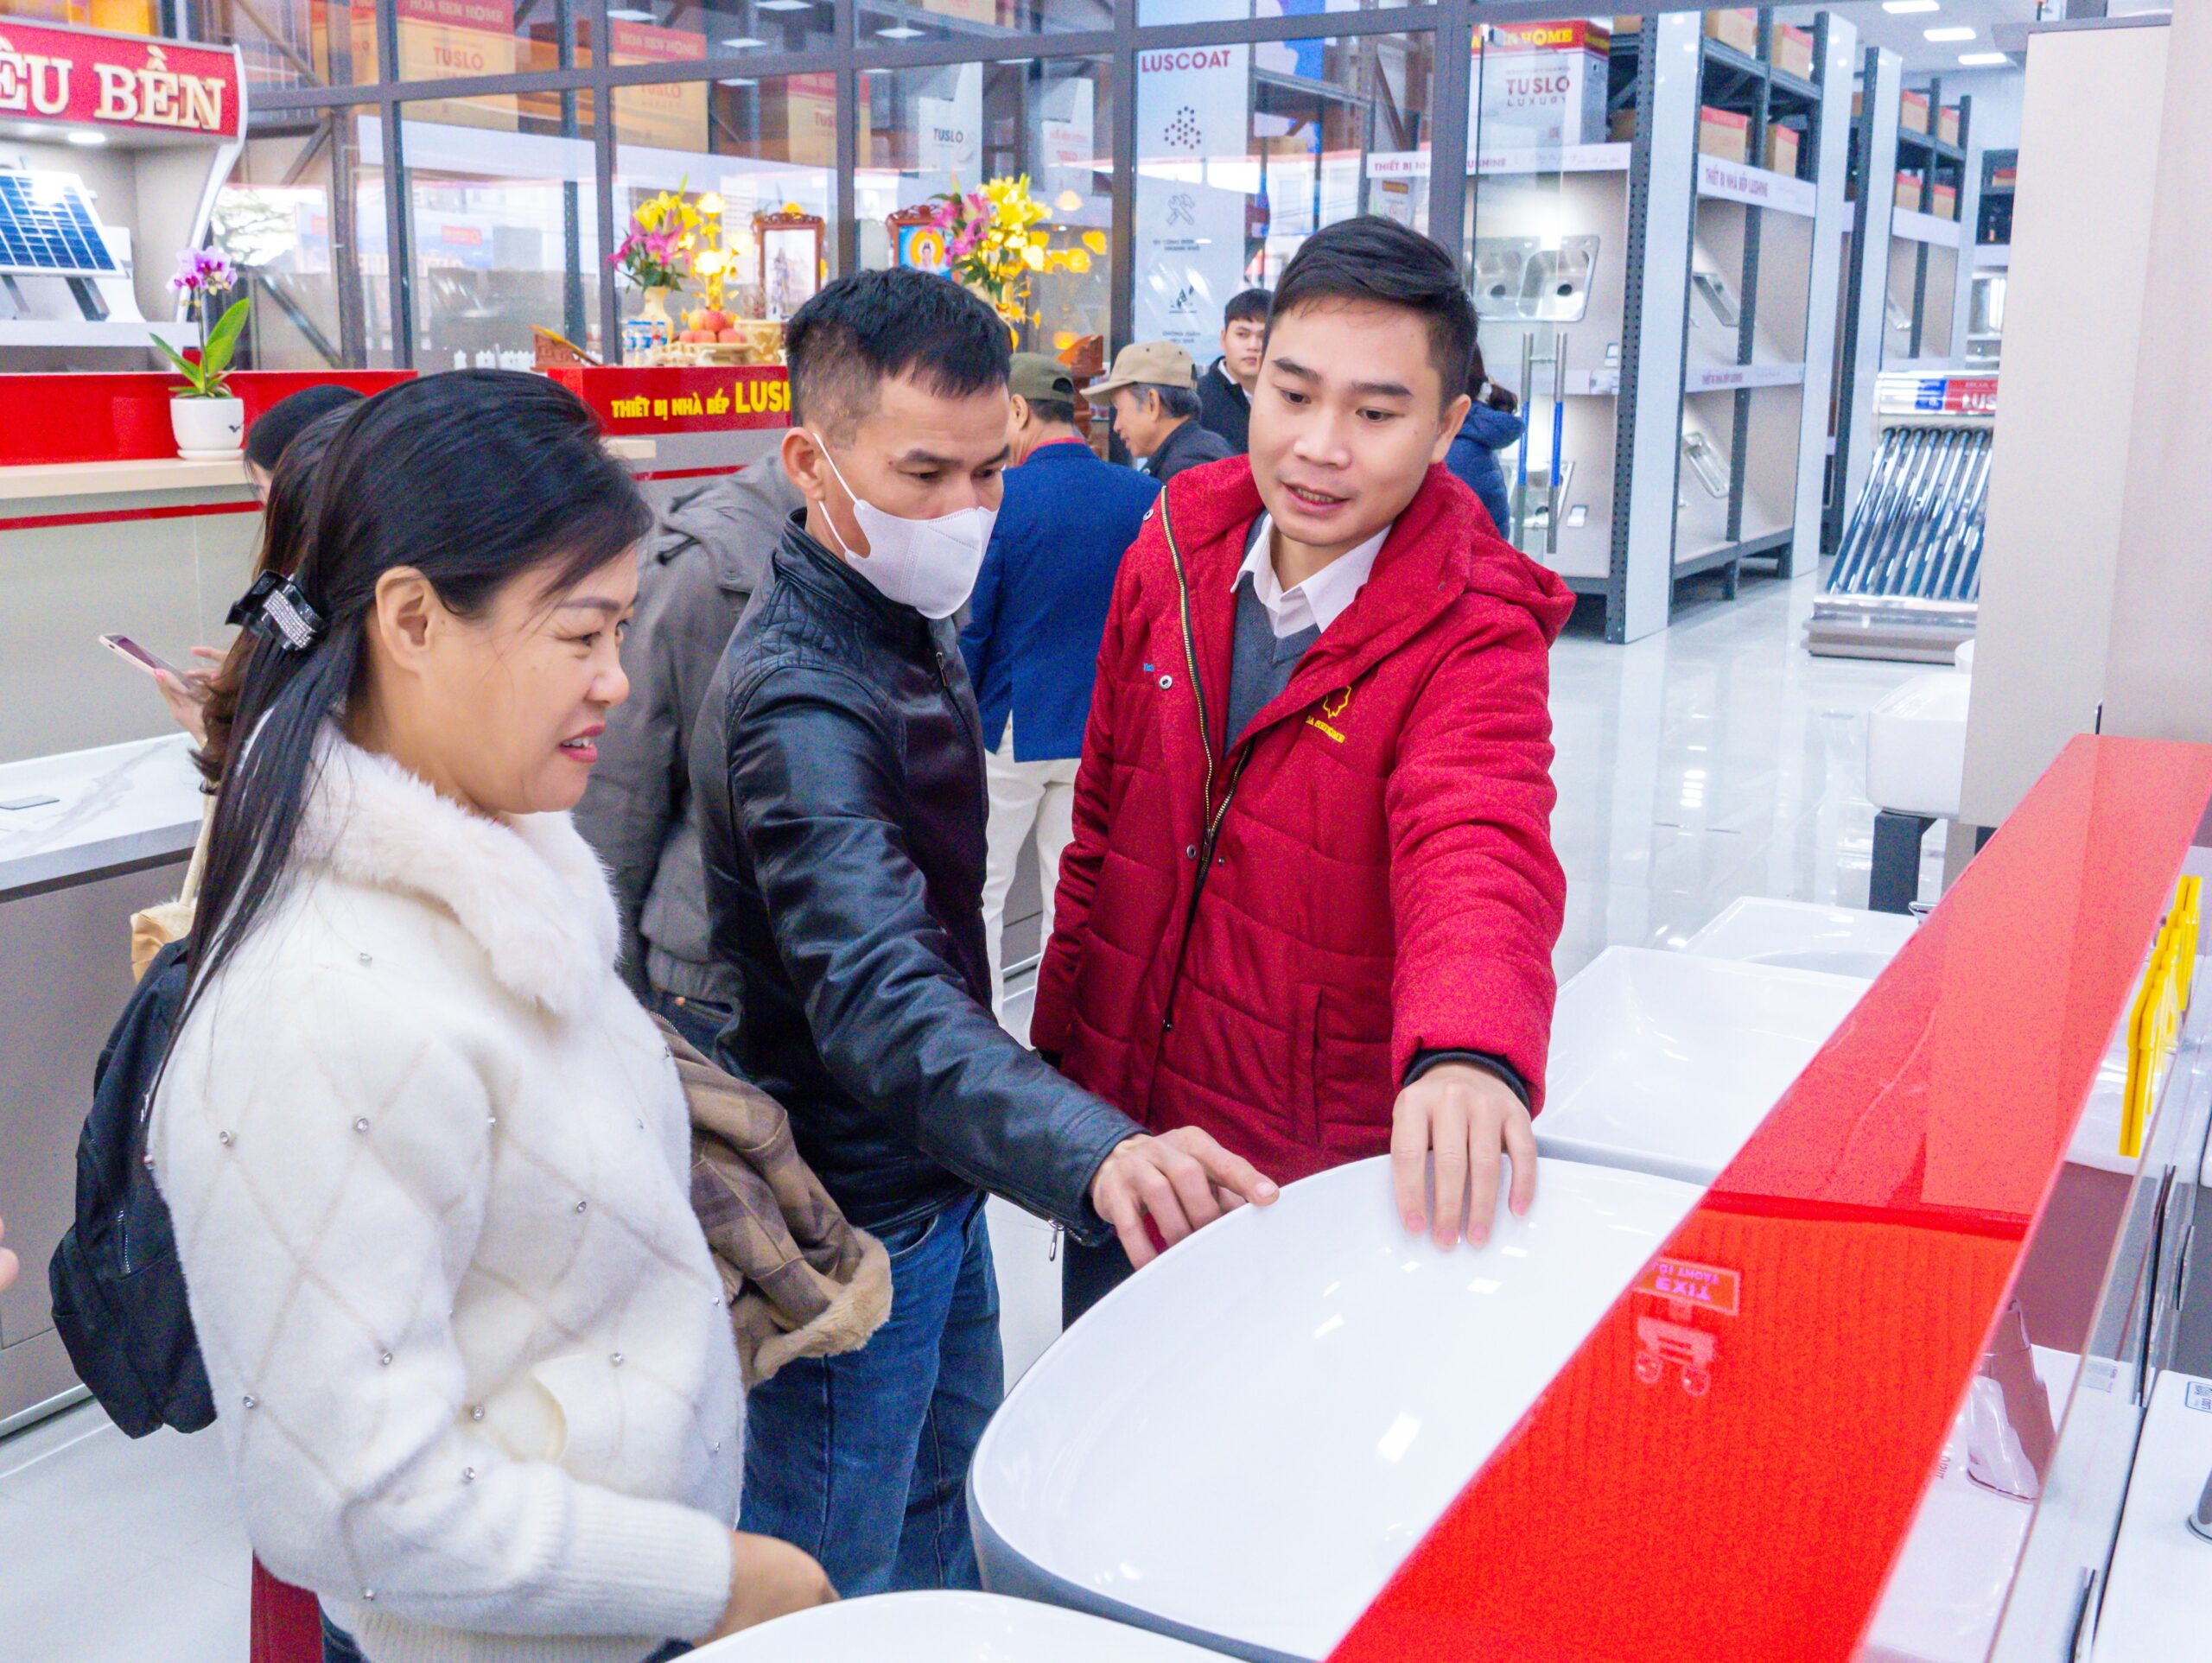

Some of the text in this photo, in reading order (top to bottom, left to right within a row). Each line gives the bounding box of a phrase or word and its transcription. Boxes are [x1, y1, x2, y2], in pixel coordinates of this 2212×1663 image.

[1521, 27, 1573, 46] HOME
[433, 46, 485, 70] TUSLO
[1141, 50, 1230, 73] LUSCOAT
[93, 45, 226, 130] BỀN
[1506, 75, 1570, 96] TUSLO
[611, 395, 650, 418] THIẾT
[654, 399, 668, 422] BỊ
[671, 391, 703, 416] NHÀ
[706, 387, 730, 415] BẾP
